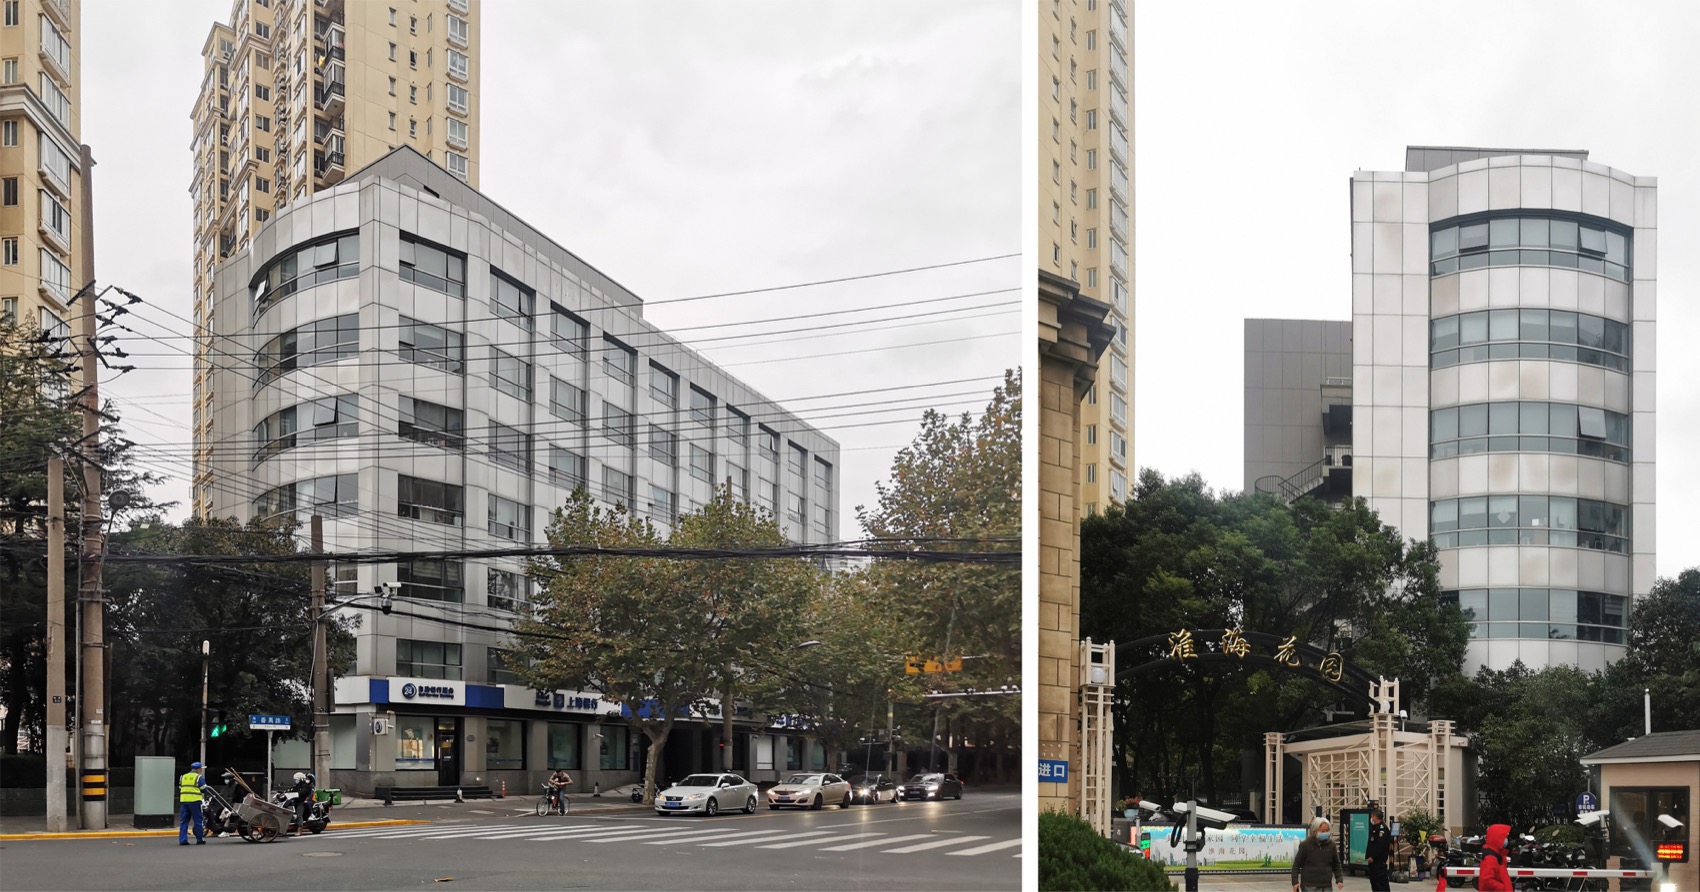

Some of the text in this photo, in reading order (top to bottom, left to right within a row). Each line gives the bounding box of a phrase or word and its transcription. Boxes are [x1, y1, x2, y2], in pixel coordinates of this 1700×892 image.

[1168, 628, 1344, 683] 淮海花园
[1038, 763, 1065, 778] 进口
[1583, 794, 1590, 804] P
